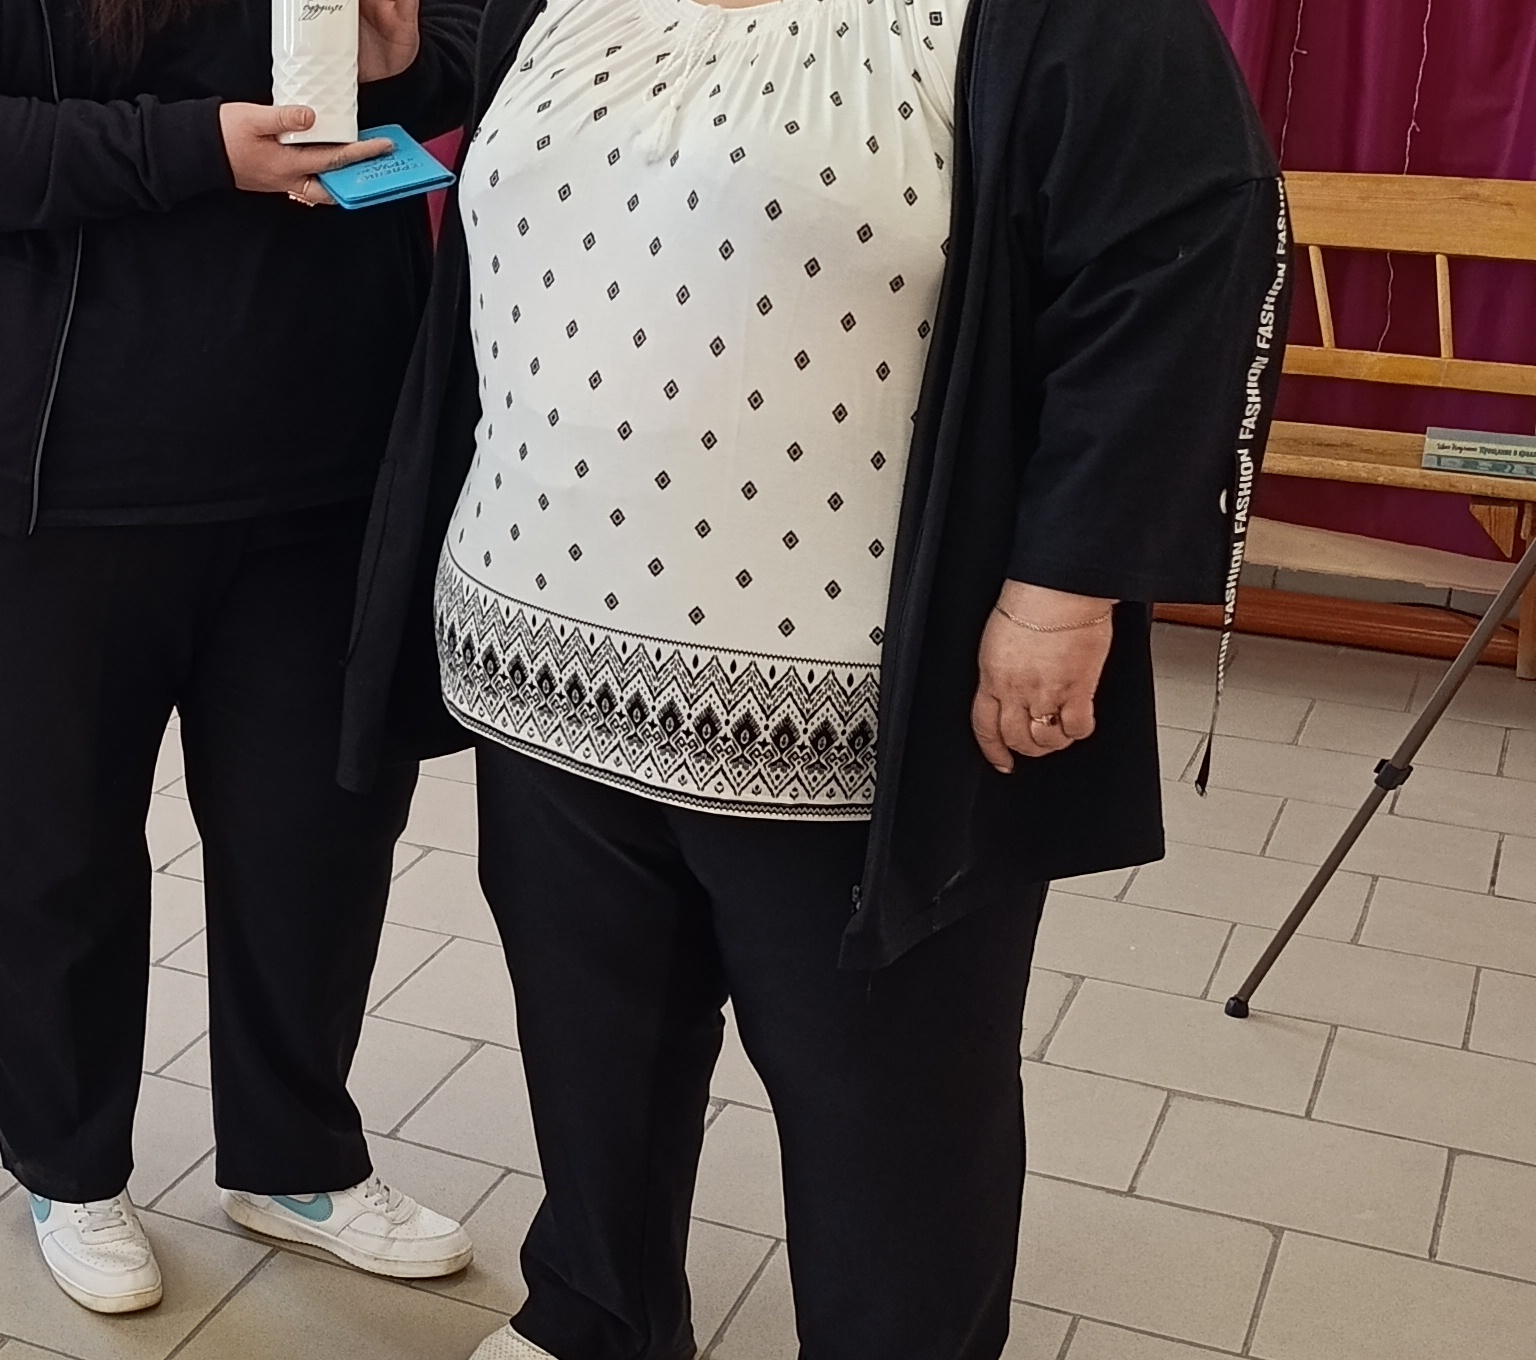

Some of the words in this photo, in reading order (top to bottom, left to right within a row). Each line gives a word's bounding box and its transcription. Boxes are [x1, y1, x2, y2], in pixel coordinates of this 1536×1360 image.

[1256, 262, 1286, 349] FASHION
[1239, 355, 1269, 440] FASHION
[1234, 448, 1255, 534] FASHION
[1224, 540, 1245, 625] FASHION
